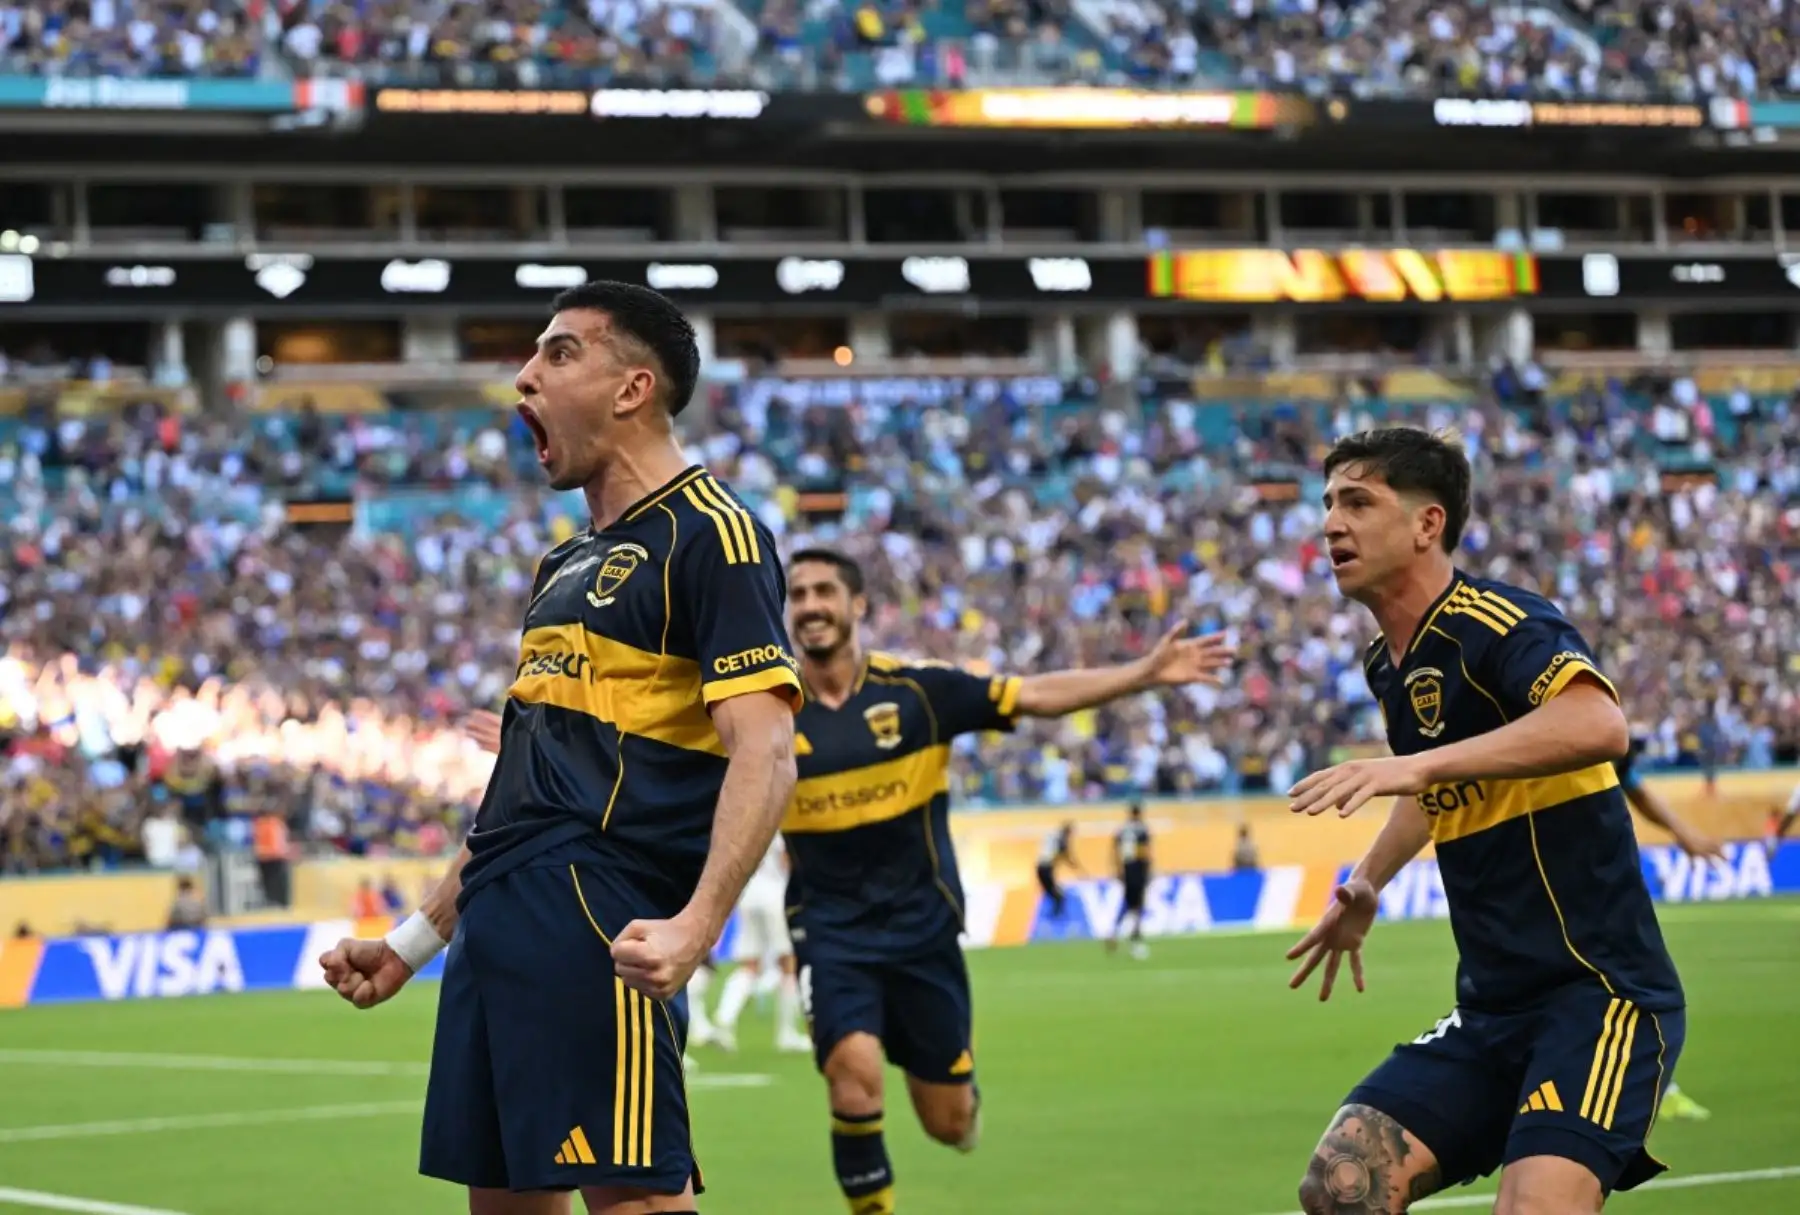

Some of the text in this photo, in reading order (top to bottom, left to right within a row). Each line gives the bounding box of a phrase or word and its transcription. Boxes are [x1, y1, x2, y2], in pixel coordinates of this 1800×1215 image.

[1651, 840, 1773, 903] VISA
[1078, 873, 1211, 939] VSA
[79, 929, 246, 999] VISA
